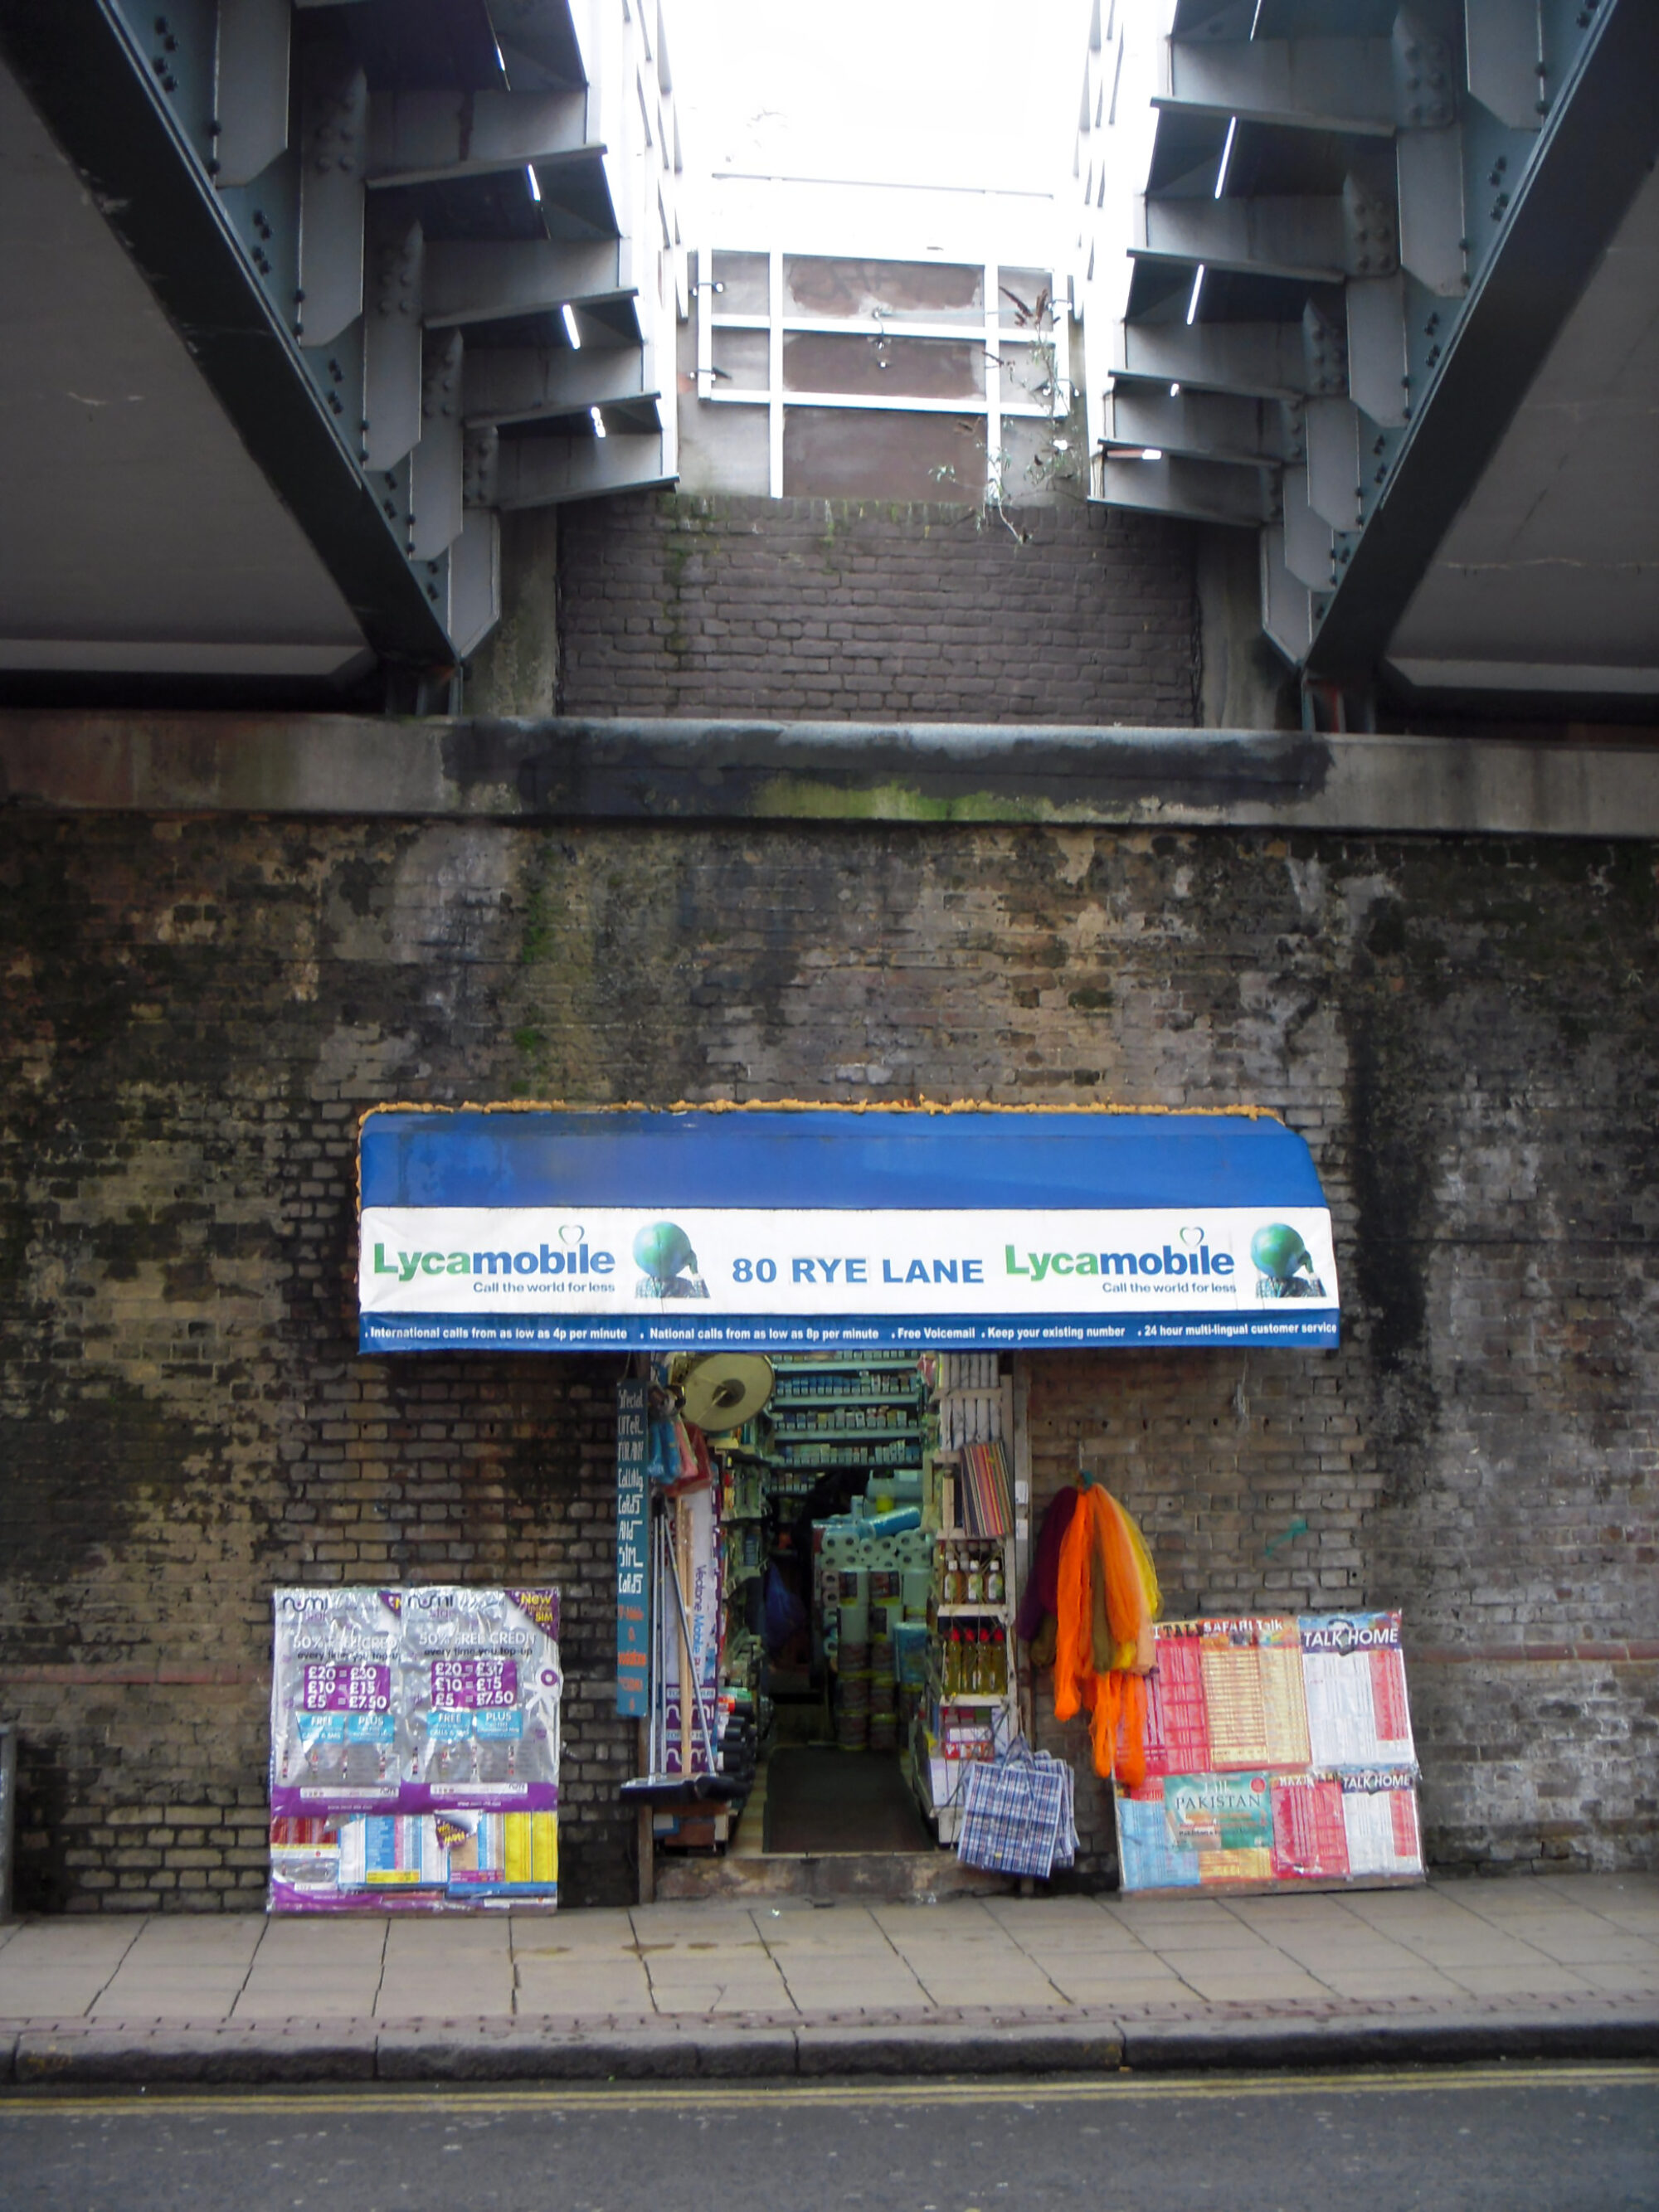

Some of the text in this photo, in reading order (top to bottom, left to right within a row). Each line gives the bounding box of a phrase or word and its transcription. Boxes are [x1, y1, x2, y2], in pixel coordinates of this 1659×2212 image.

[374, 1242, 615, 1281] Lycamobile
[1005, 1244, 1235, 1281] Lycamobile
[732, 1257, 984, 1283] 80 RYE LANE
[473, 1281, 615, 1293] Call the world for less
[1102, 1282, 1237, 1293] Call the world for less
[370, 1326, 627, 1341] International calls from as low as 4p per minute
[649, 1328, 878, 1342] National calls from as low as 8p per minute
[898, 1327, 975, 1339] Free Voicemail
[987, 1325, 1126, 1341] Keep your existing number
[1144, 1321, 1337, 1337] 24 hour multi-lingual customer service
[693, 1564, 707, 1612] Vectone
[521, 1593, 552, 1606] New
[535, 1613, 553, 1622] SIM
[1204, 1618, 1283, 1634] SAFARI Talk
[419, 1632, 450, 1645] 50%
[1304, 1627, 1399, 1647] TALK HOME
[424, 1647, 533, 1658] every time you top-up
[308, 1665, 336, 1680] £20
[350, 1666, 377, 1680] £30
[435, 1662, 462, 1676] £20
[308, 1680, 336, 1694] £10
[349, 1681, 375, 1695] £15
[435, 1677, 462, 1692] £10
[476, 1676, 502, 1692] £15
[307, 1695, 327, 1709] £5
[349, 1695, 387, 1709] £7.50
[435, 1693, 455, 1706] £5
[358, 1714, 384, 1726] PLUS
[438, 1713, 461, 1723] FREE
[485, 1711, 512, 1722] PLUS
[1343, 1776, 1371, 1789] TALK
[1374, 1773, 1411, 1787] HOME
[1175, 1792, 1261, 1811] PAKISTAN
